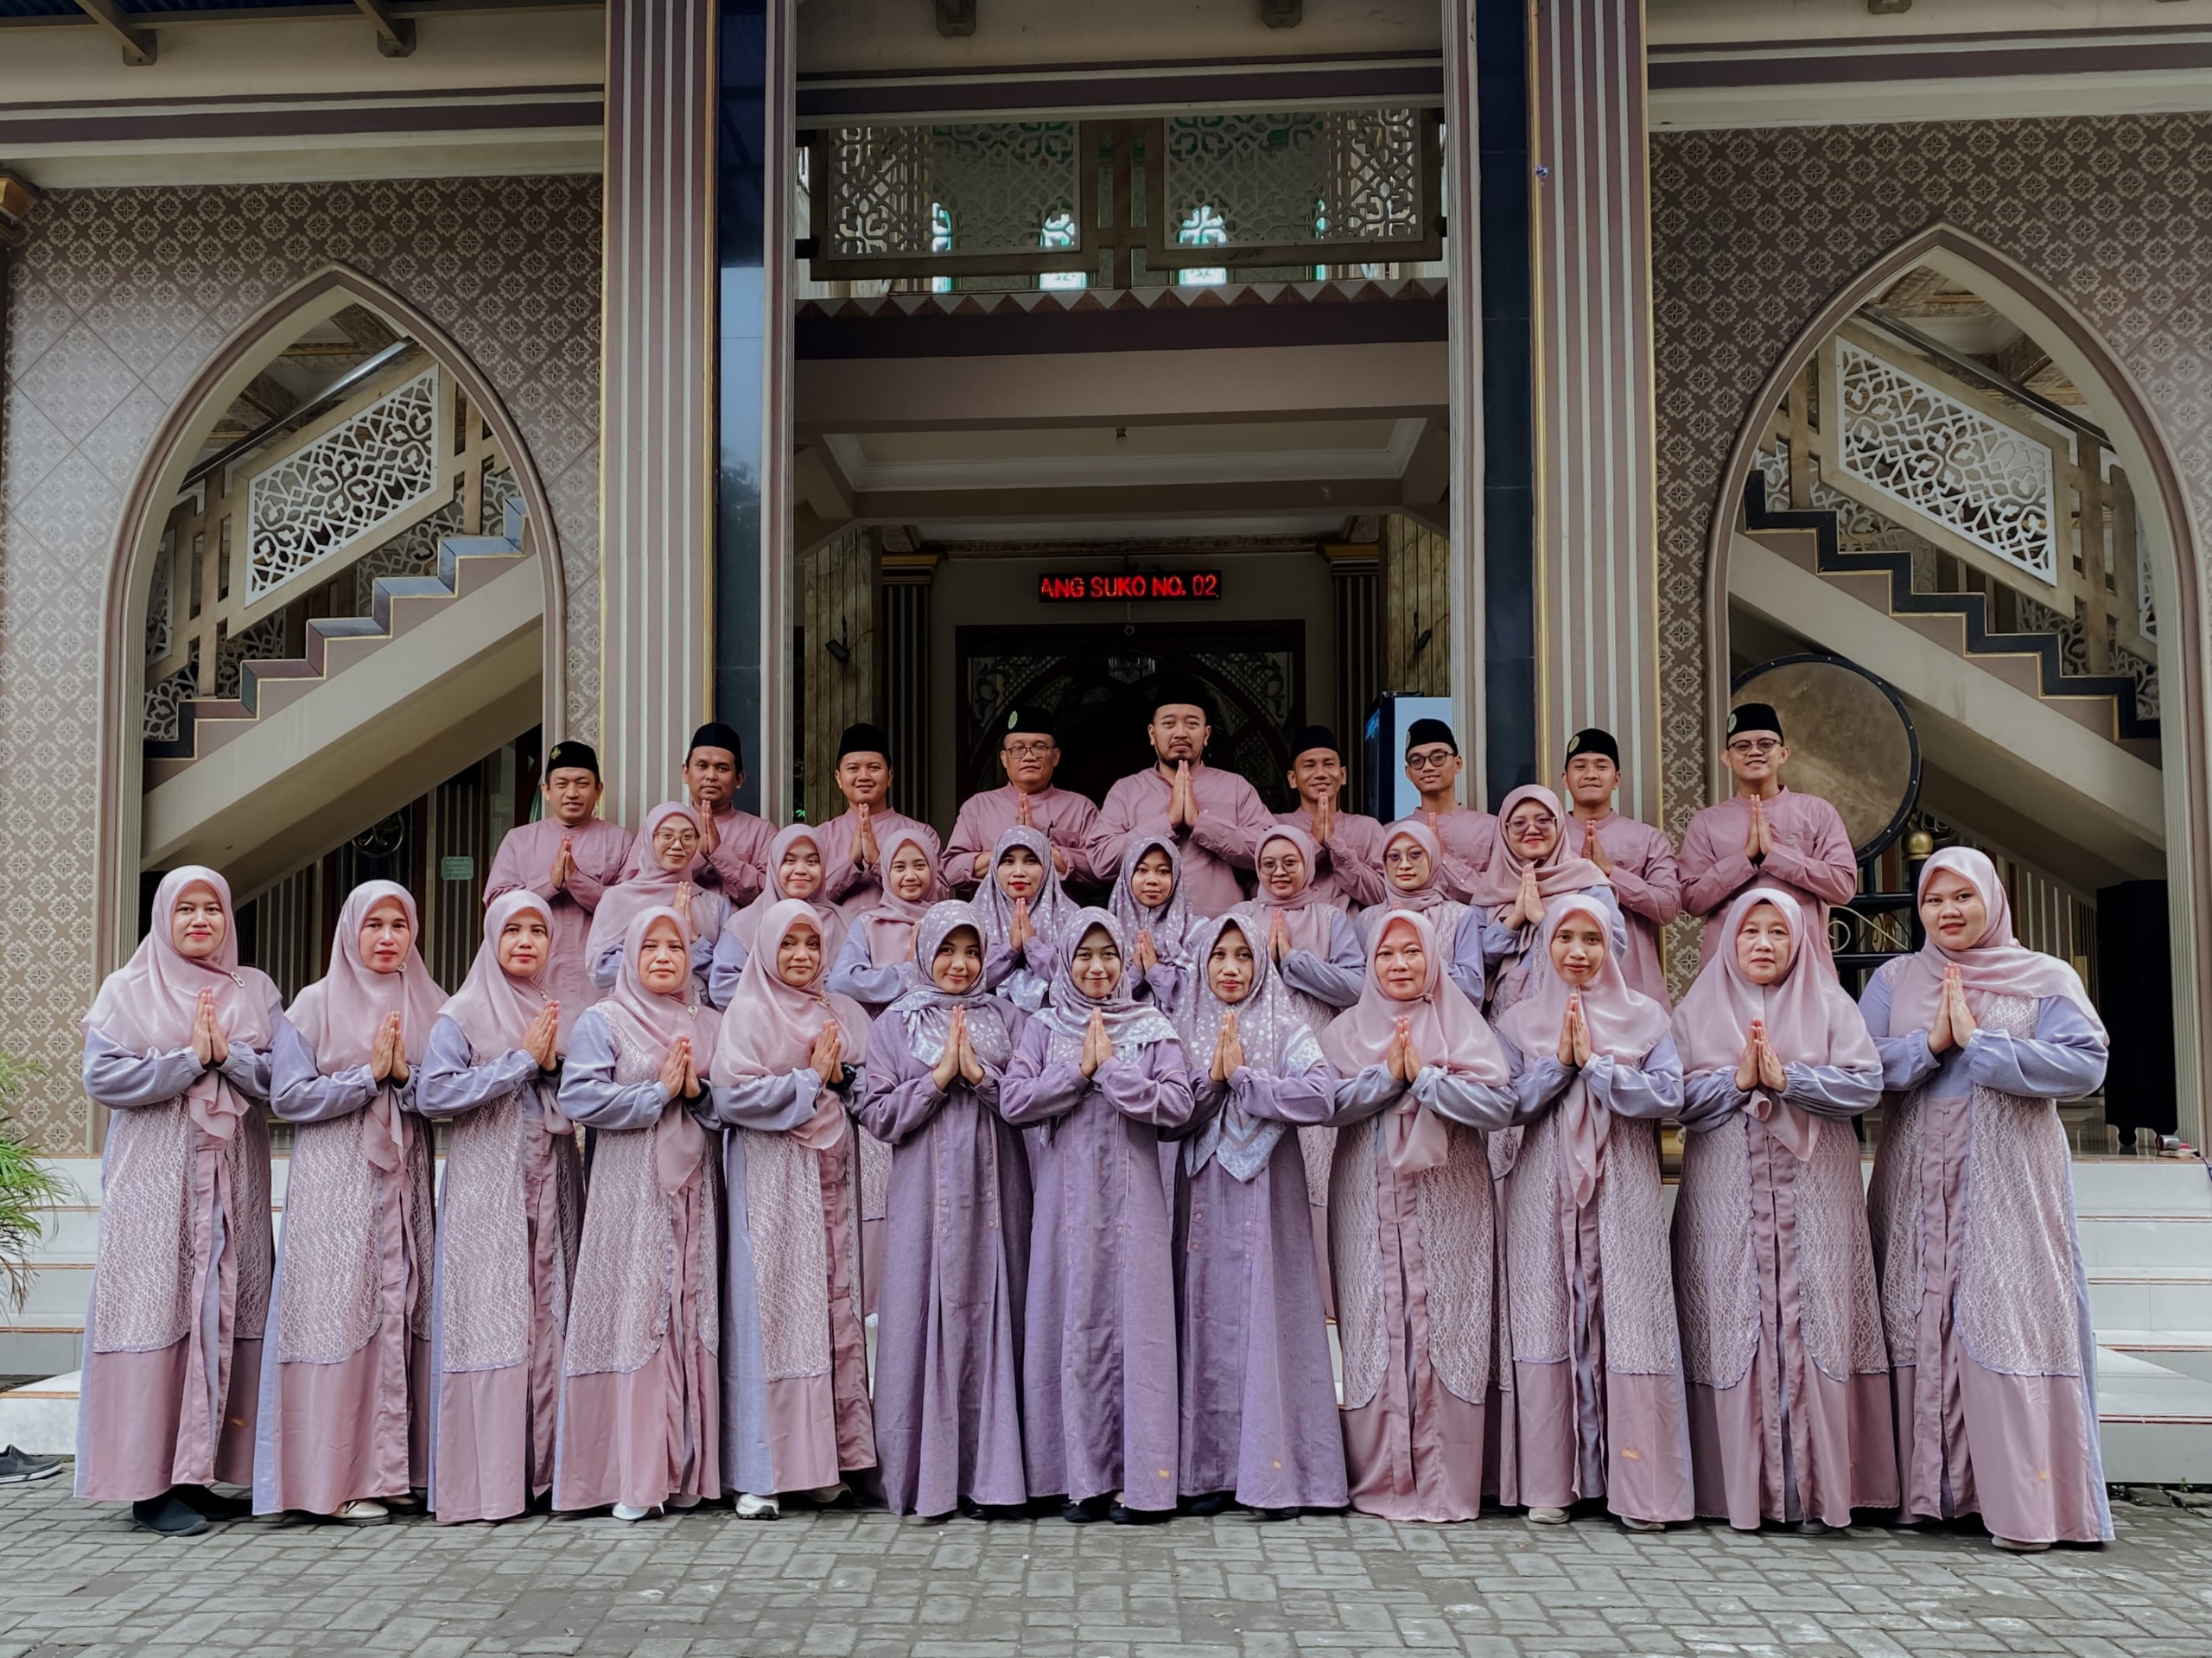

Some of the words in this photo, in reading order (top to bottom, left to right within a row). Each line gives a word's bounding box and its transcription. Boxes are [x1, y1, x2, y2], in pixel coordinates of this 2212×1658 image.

[1041, 577, 1084, 598] ANG
[1090, 576, 1146, 596] SUKO
[1152, 575, 1186, 596] NO.
[1192, 574, 1217, 595] 02
